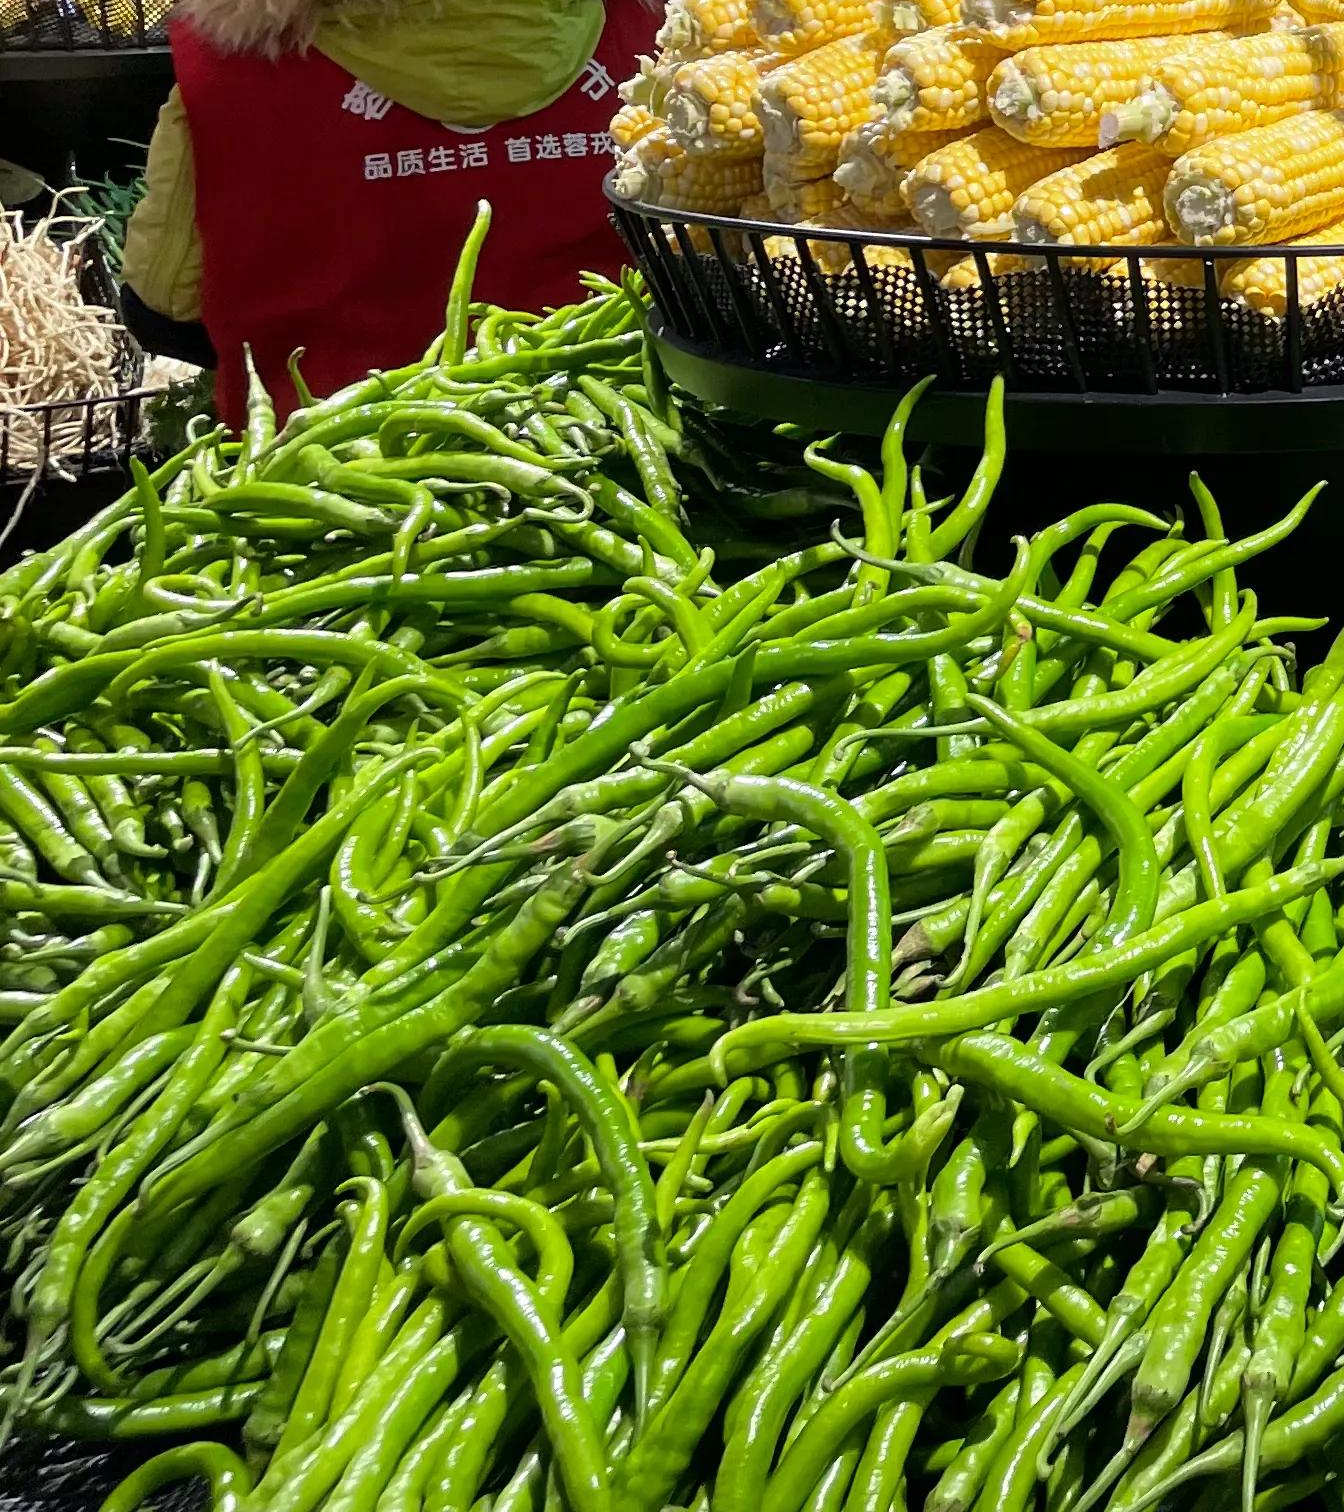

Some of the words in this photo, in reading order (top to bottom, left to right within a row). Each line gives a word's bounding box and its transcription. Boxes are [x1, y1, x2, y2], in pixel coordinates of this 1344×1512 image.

[363, 141, 489, 180] 品质生活
[504, 130, 617, 163] 首选蓉戎
